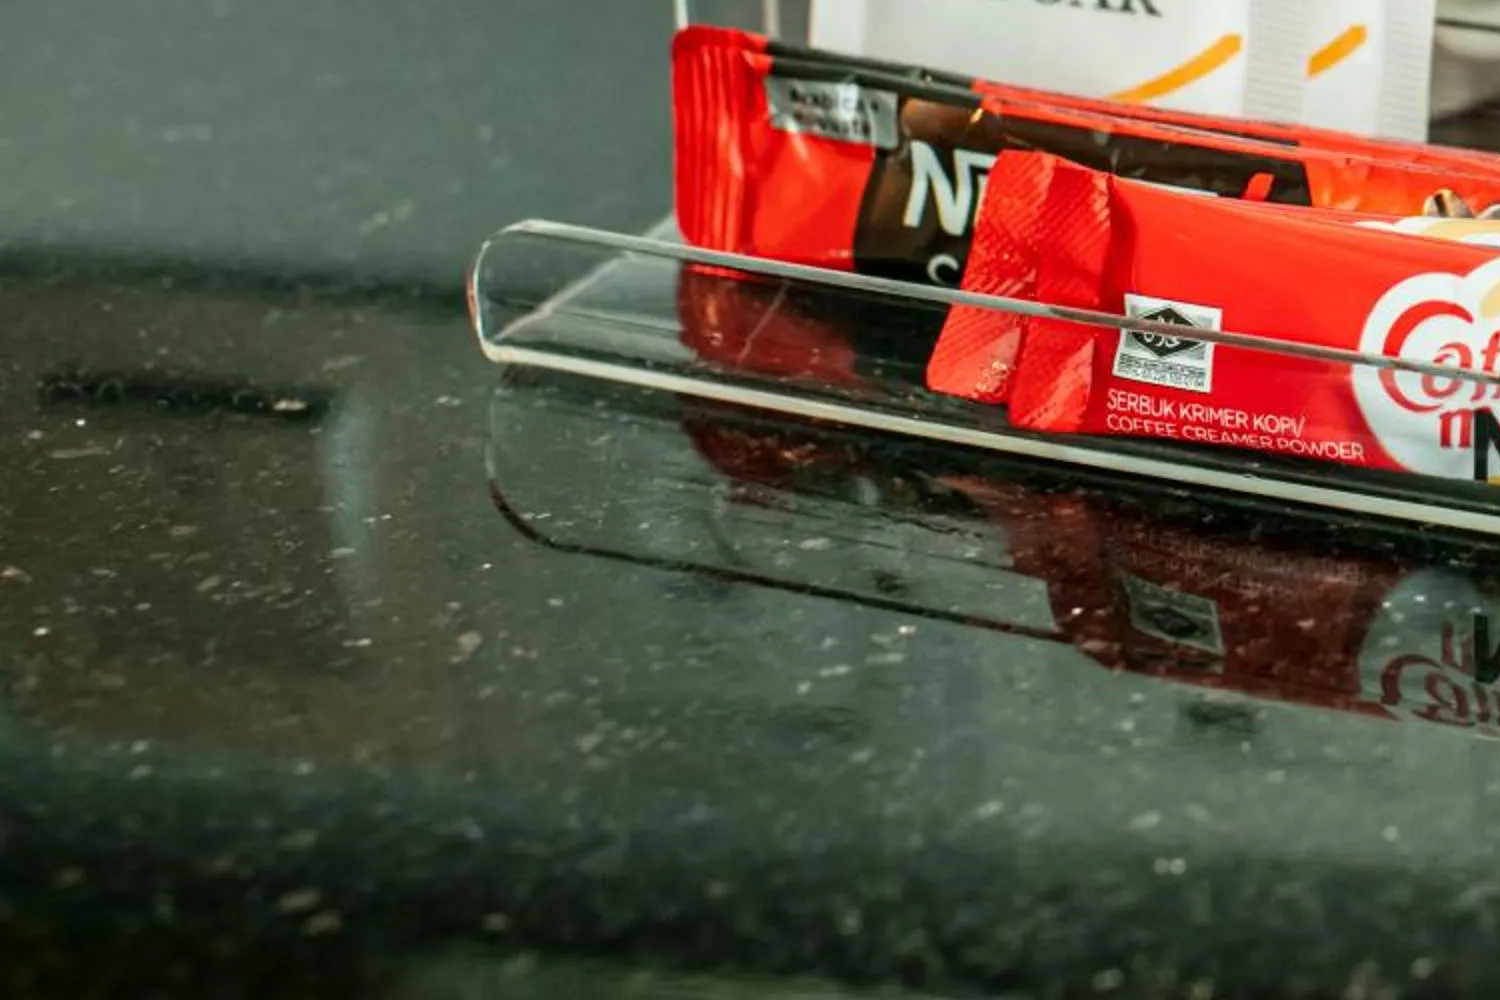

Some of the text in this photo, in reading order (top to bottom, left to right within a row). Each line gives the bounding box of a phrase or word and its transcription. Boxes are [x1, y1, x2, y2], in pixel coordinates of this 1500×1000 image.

[1108, 388, 1176, 420] SERBUK
[1180, 401, 1249, 430] KRIMER
[1107, 414, 1177, 436] COFFEE
[1278, 439, 1365, 462] POWDER
